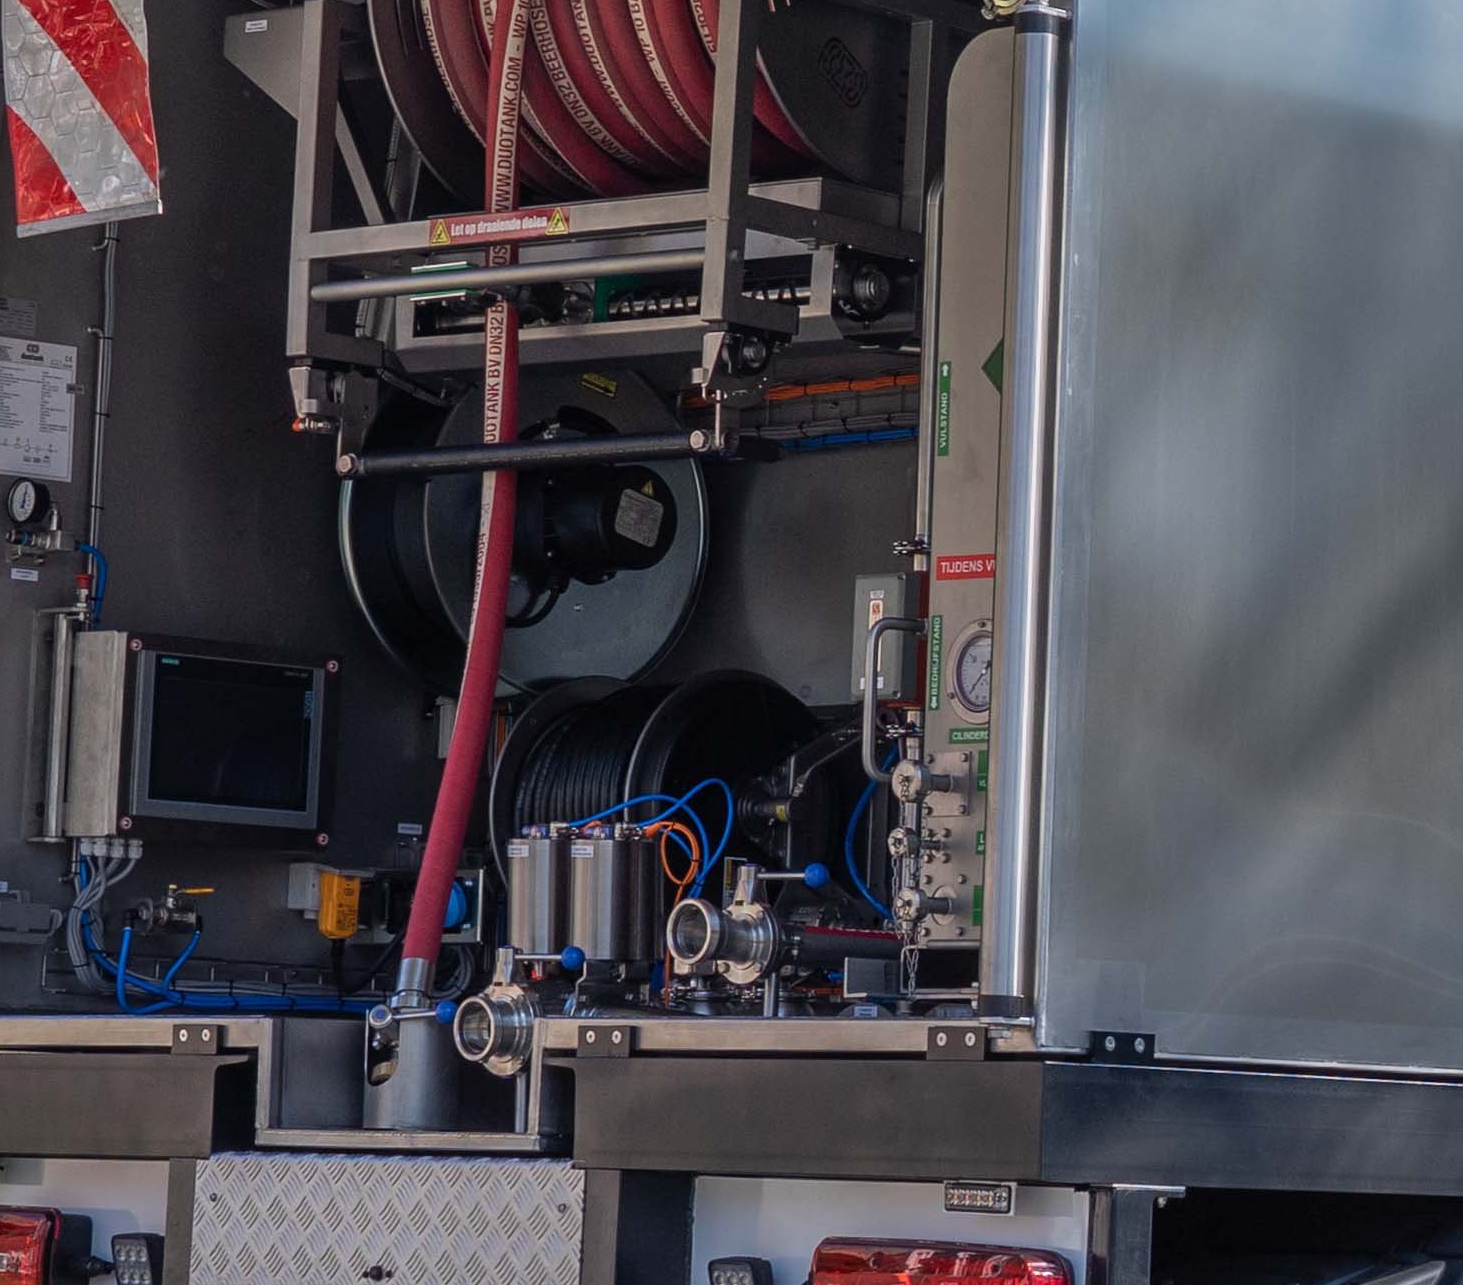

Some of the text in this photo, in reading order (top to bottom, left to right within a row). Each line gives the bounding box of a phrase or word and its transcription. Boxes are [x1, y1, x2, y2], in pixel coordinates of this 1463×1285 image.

[530, 0, 567, 86] BEERHOSE
[494, 57, 522, 213] WWW.DUOTANK.COM
[511, 13, 528, 39] WP
[451, 223, 464, 236] Let
[465, 223, 476, 237] op
[488, 316, 505, 356] DN32
[486, 358, 501, 379] BV
[486, 382, 501, 444] UOTANK
[939, 392, 948, 448] VULSTAND
[940, 561, 984, 574] TIJDENS
[931, 617, 941, 695] BEDRIJFSTAND
